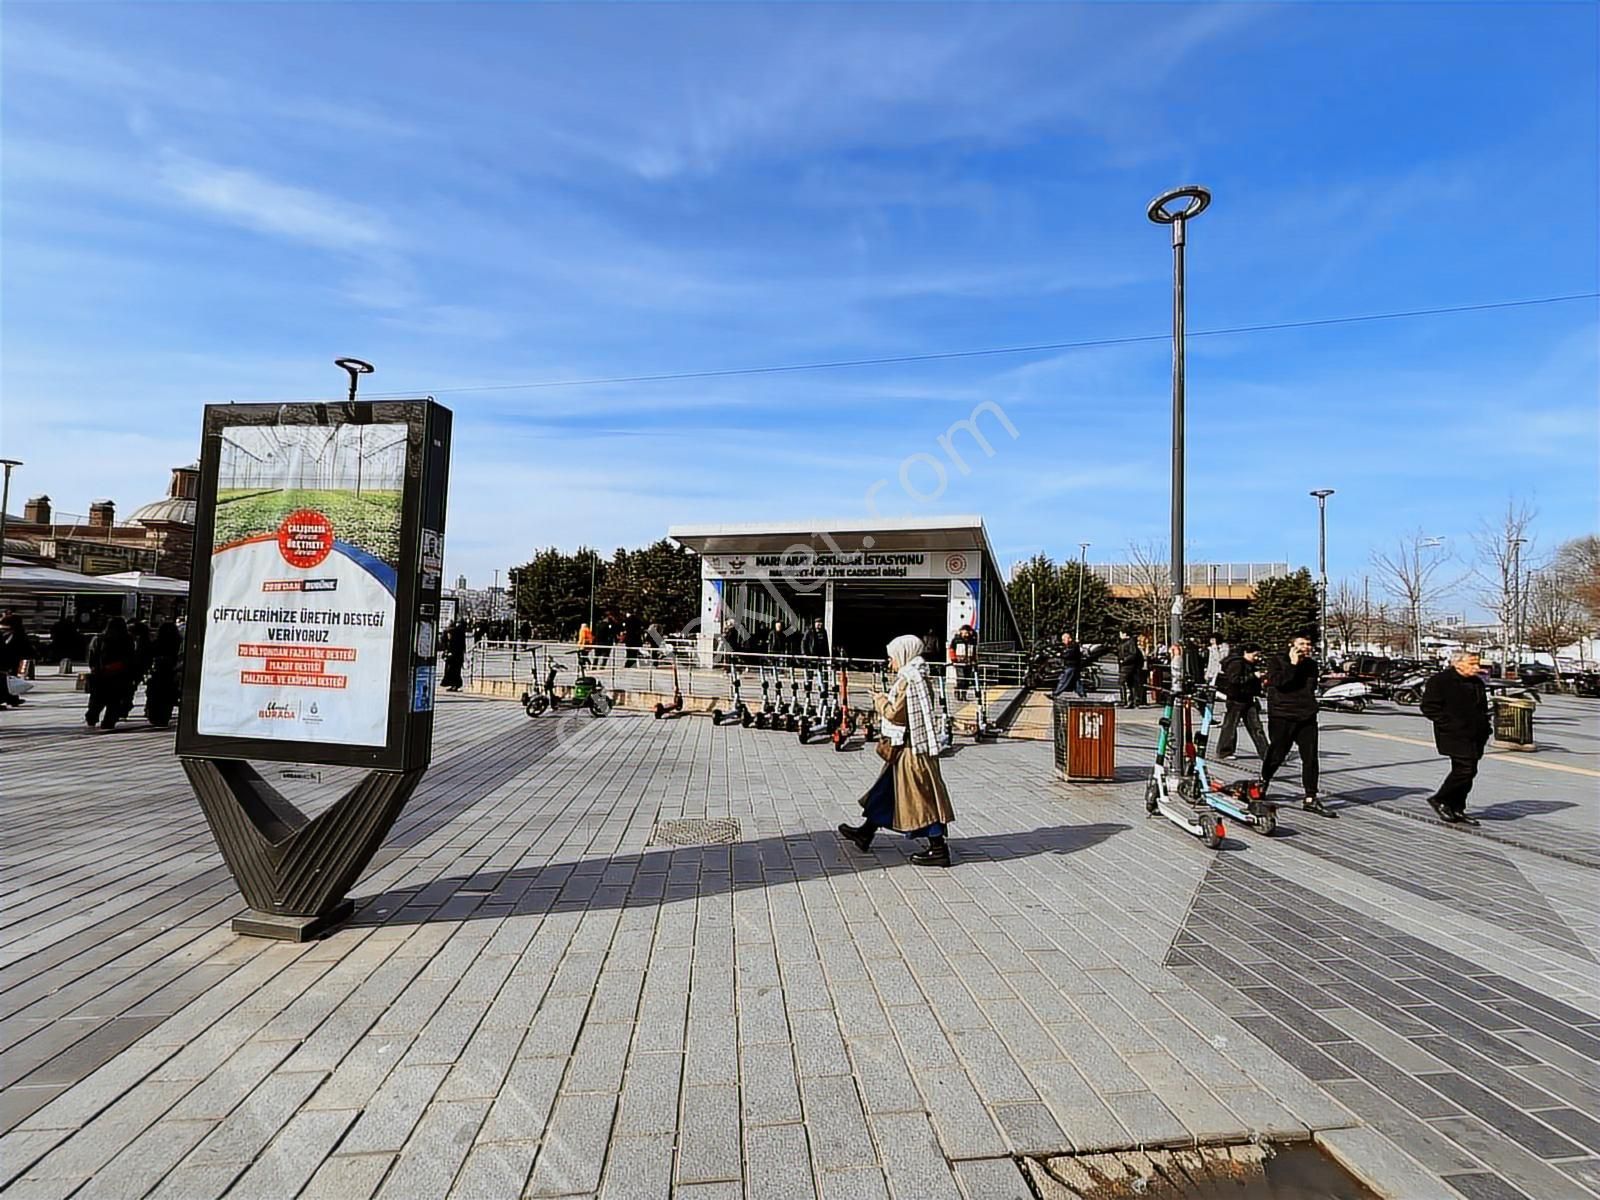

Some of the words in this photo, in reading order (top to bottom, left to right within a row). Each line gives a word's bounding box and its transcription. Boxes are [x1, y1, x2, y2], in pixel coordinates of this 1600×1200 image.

[755, 555, 807, 567] MARARAY
[864, 552, 924, 566] İSTASYONU
[213, 605, 297, 625] ÇİFTÇİLERİMİZE
[300, 608, 341, 625] ÜRETİM
[343, 610, 385, 627] DESTEĞİ
[267, 625, 329, 643] VERİYORUZ
